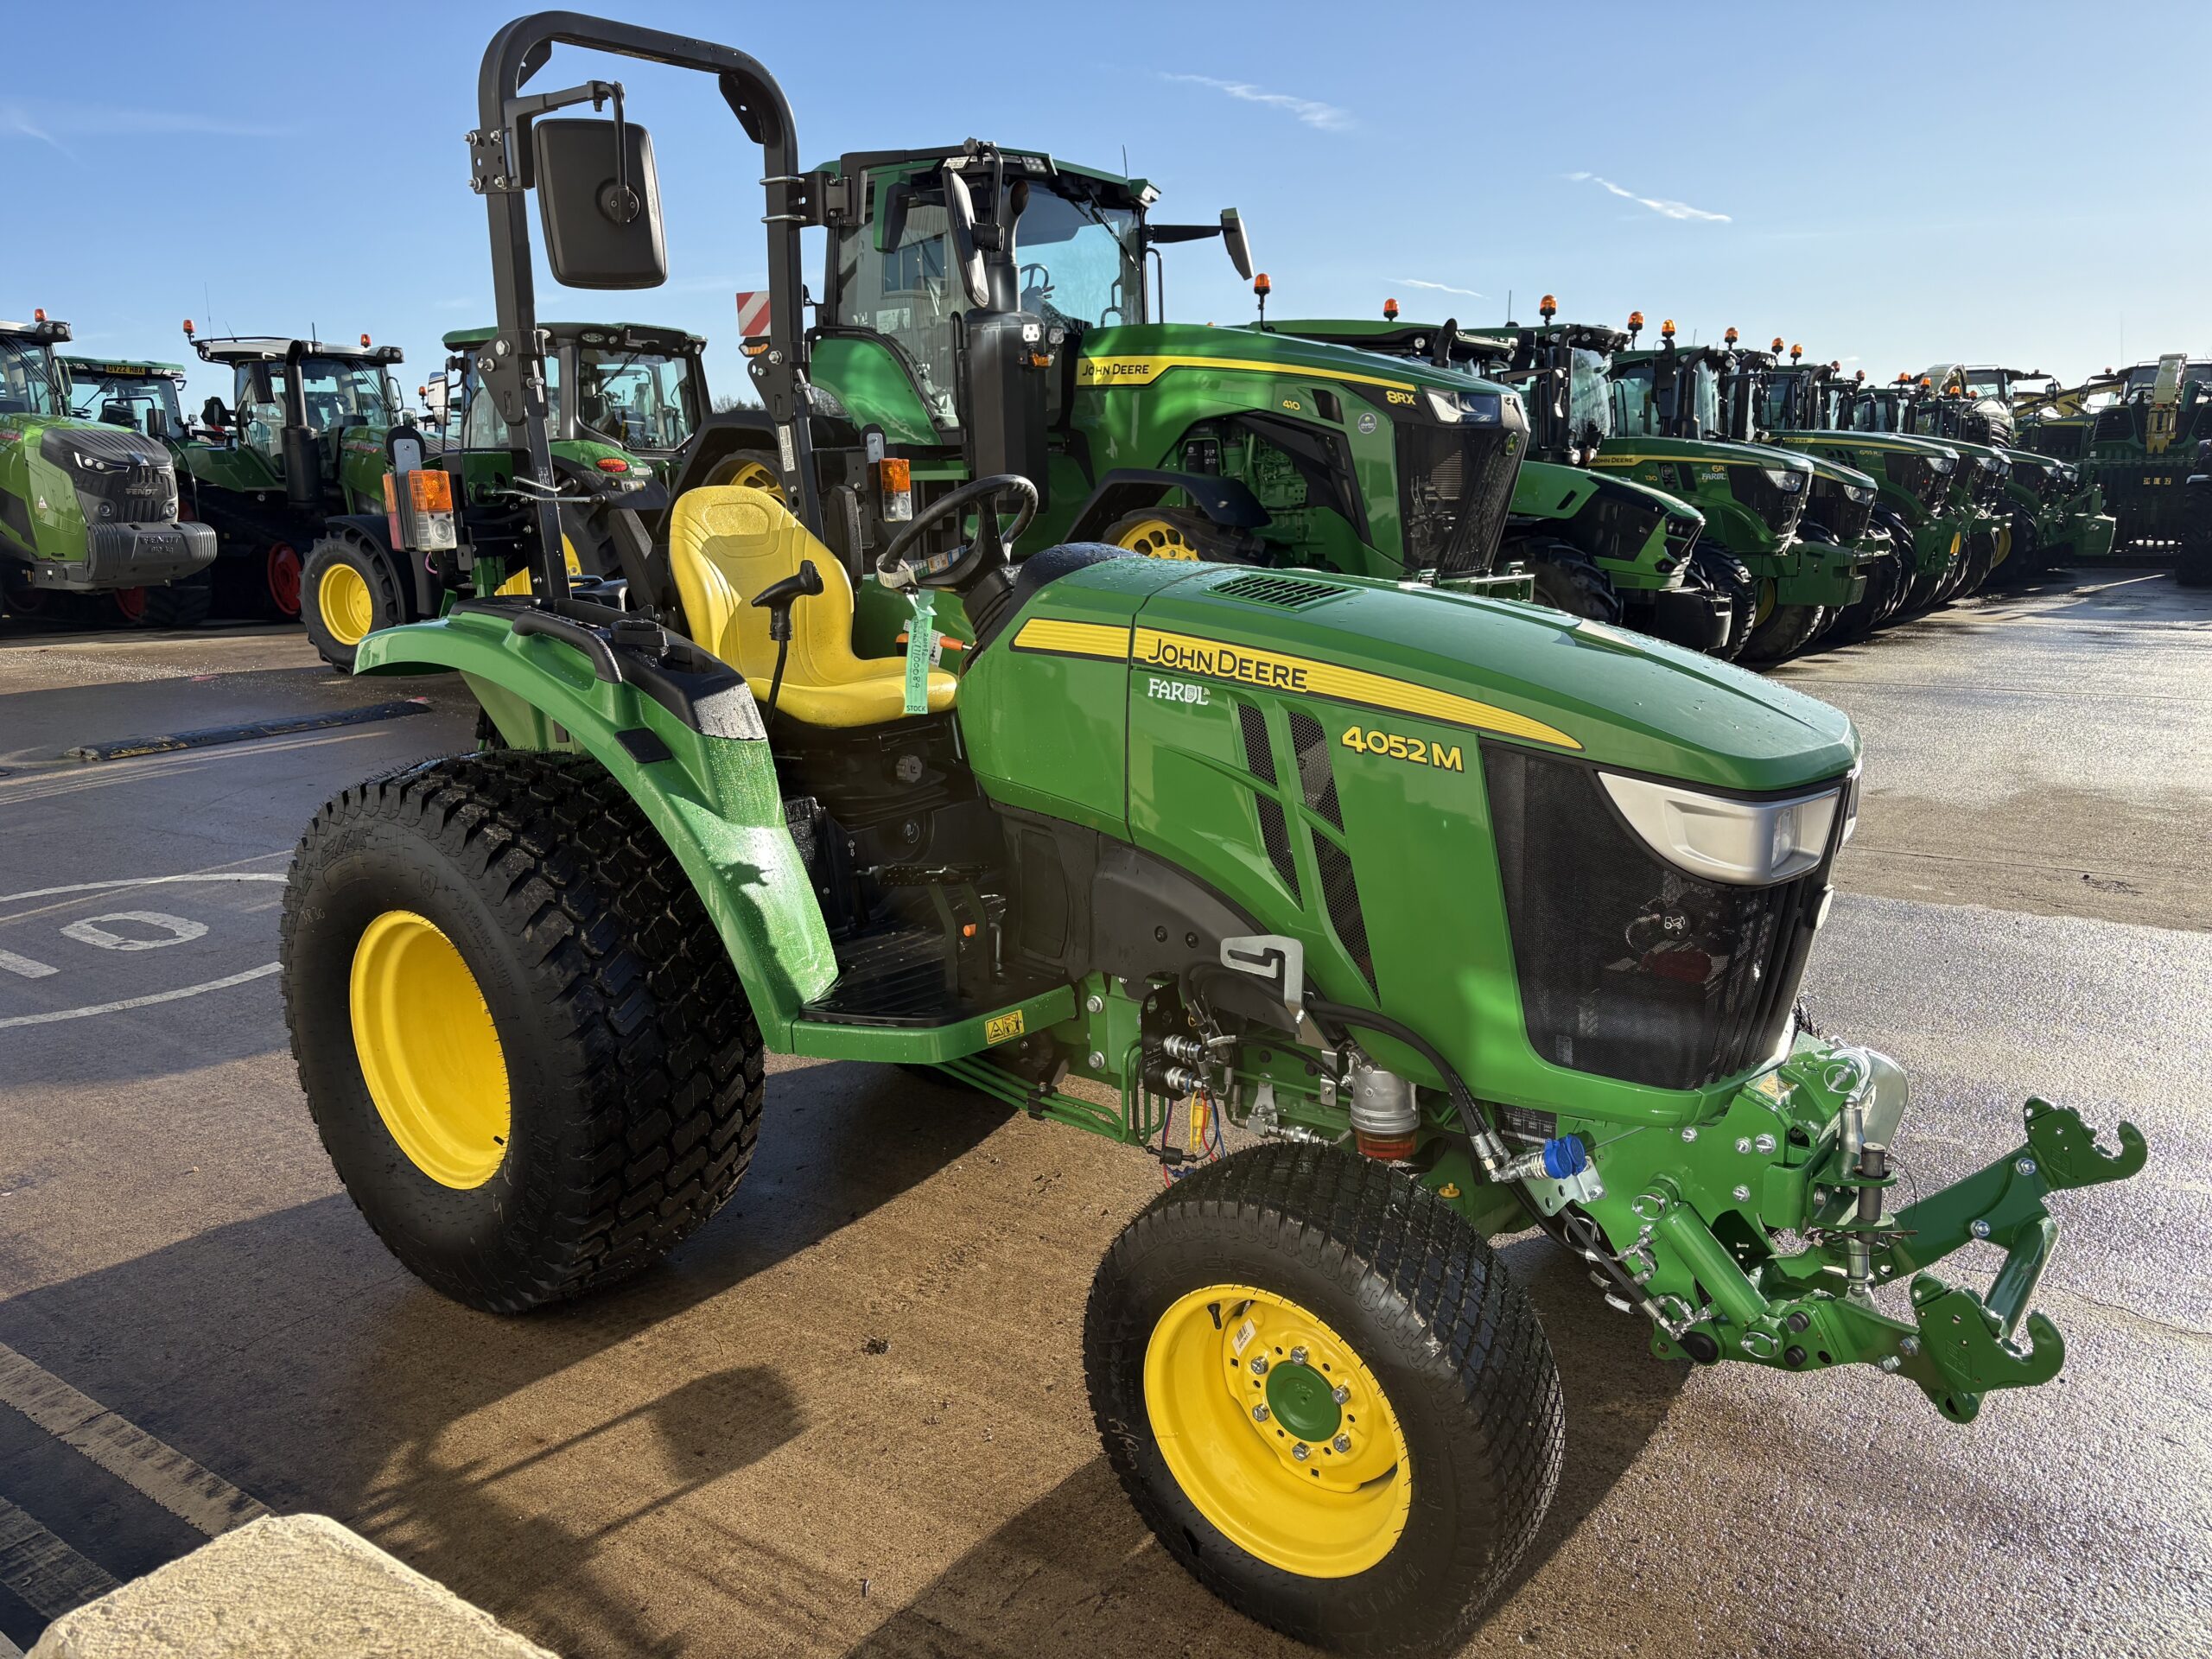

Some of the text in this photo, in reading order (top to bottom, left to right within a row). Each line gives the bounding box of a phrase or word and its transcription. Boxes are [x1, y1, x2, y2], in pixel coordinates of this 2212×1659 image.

[1082, 363, 1149, 376] JOHN DEERE
[1282, 399, 1301, 410] 410
[1385, 391, 1417, 405] 8RX
[1147, 638, 1308, 690] JOHN DEERE
